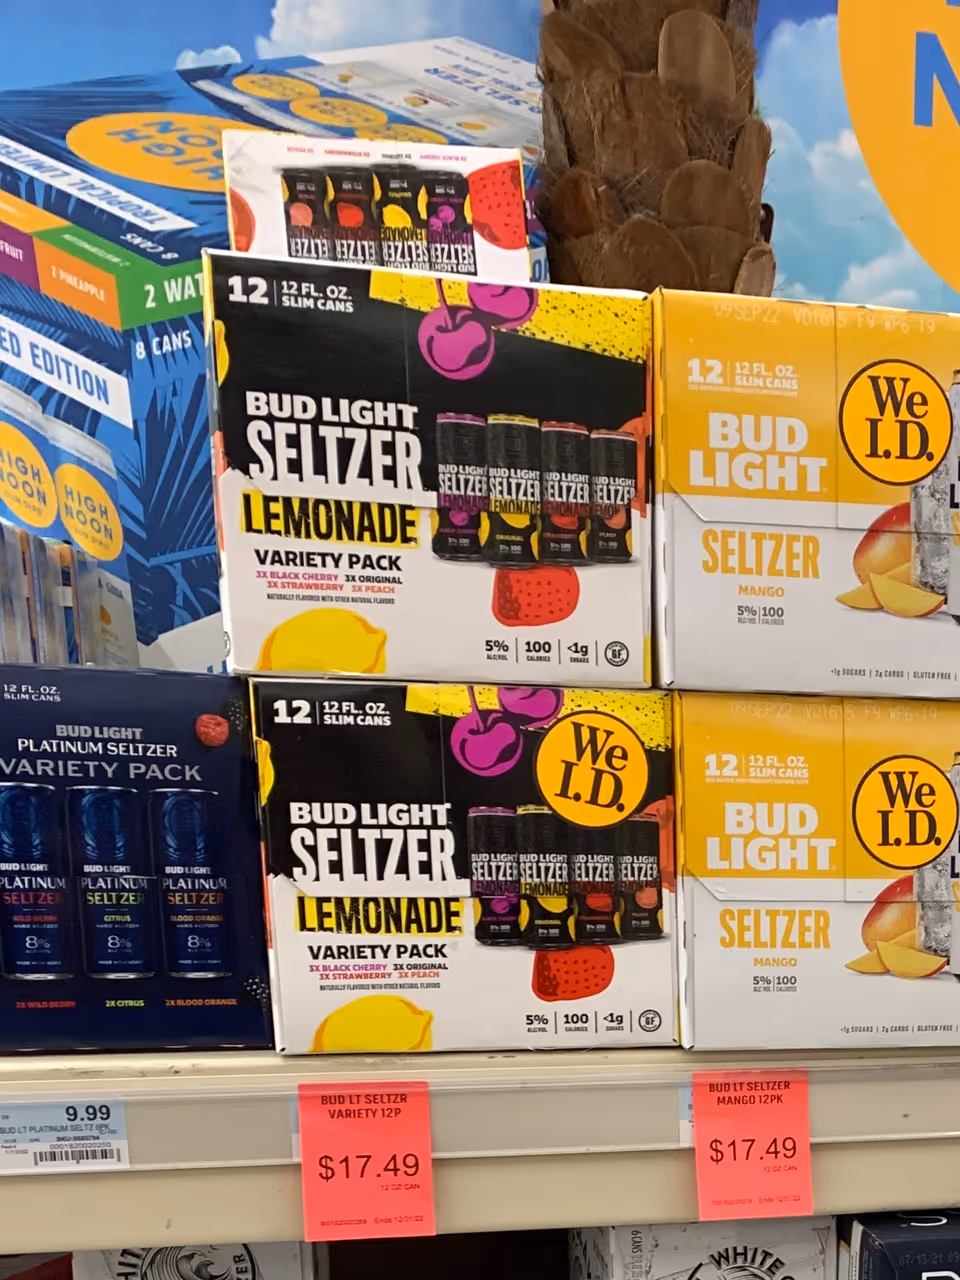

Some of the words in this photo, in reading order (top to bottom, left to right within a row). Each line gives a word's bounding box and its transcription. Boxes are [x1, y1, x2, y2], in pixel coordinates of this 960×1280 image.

[51, 266, 56, 277] 2
[60, 268, 105, 301] PINEAPPLE
[228, 276, 268, 304] 12
[136, 342, 144, 359] 8
[153, 330, 192, 356] CANS
[30, 342, 109, 405] EDITION
[245, 391, 316, 418] BUD
[322, 396, 417, 428] LIGHT
[867, 375, 929, 418] We
[709, 412, 808, 453] BUD
[866, 418, 934, 461] I.D.
[246, 420, 424, 491] SELTZER
[689, 450, 827, 492] LIGHT
[242, 493, 417, 544] LEMONADE
[255, 549, 344, 569] VARIETY
[348, 552, 402, 571] PACK
[702, 528, 820, 579] SELTZER
[256, 571, 267, 579] 3X
[270, 571, 298, 580] BLACK
[302, 573, 338, 582] CHERRY
[345, 574, 356, 583] 3X
[359, 575, 402, 584] ORIGINAL
[267, 580, 278, 589] 3X
[281, 581, 344, 592] STRAWBERRY
[738, 585, 784, 597] MANGO
[935, 672, 951, 680] FREE
[56, 724, 92, 737] BUD
[95, 726, 142, 739] LIGHT
[18, 738, 102, 755] PLATINUM
[108, 742, 177, 758] SELTZER
[571, 721, 629, 771] We
[0, 758, 118, 778] VARIETY
[129, 763, 202, 781] PACK
[554, 760, 625, 813] I.D.
[298, 896, 461, 935] LEMONADE
[106, 1000, 115, 1008] 2X
[321, 1095, 345, 1105] BUD
[349, 1095, 362, 1104] LT
[365, 1094, 407, 1104] SELTZR
[709, 1082, 730, 1093] BUD
[734, 1082, 744, 1092] LT
[747, 1080, 790, 1092] SELTZER
[717, 1095, 755, 1106] MANGO
[758, 1094, 784, 1105] 12PK
[65, 1104, 111, 1122] 9.99
[328, 1107, 376, 1119] VARIETY
[381, 1107, 401, 1118] 12P
[709, 1137, 797, 1165] $17.49
[318, 1153, 420, 1182] $17.49
